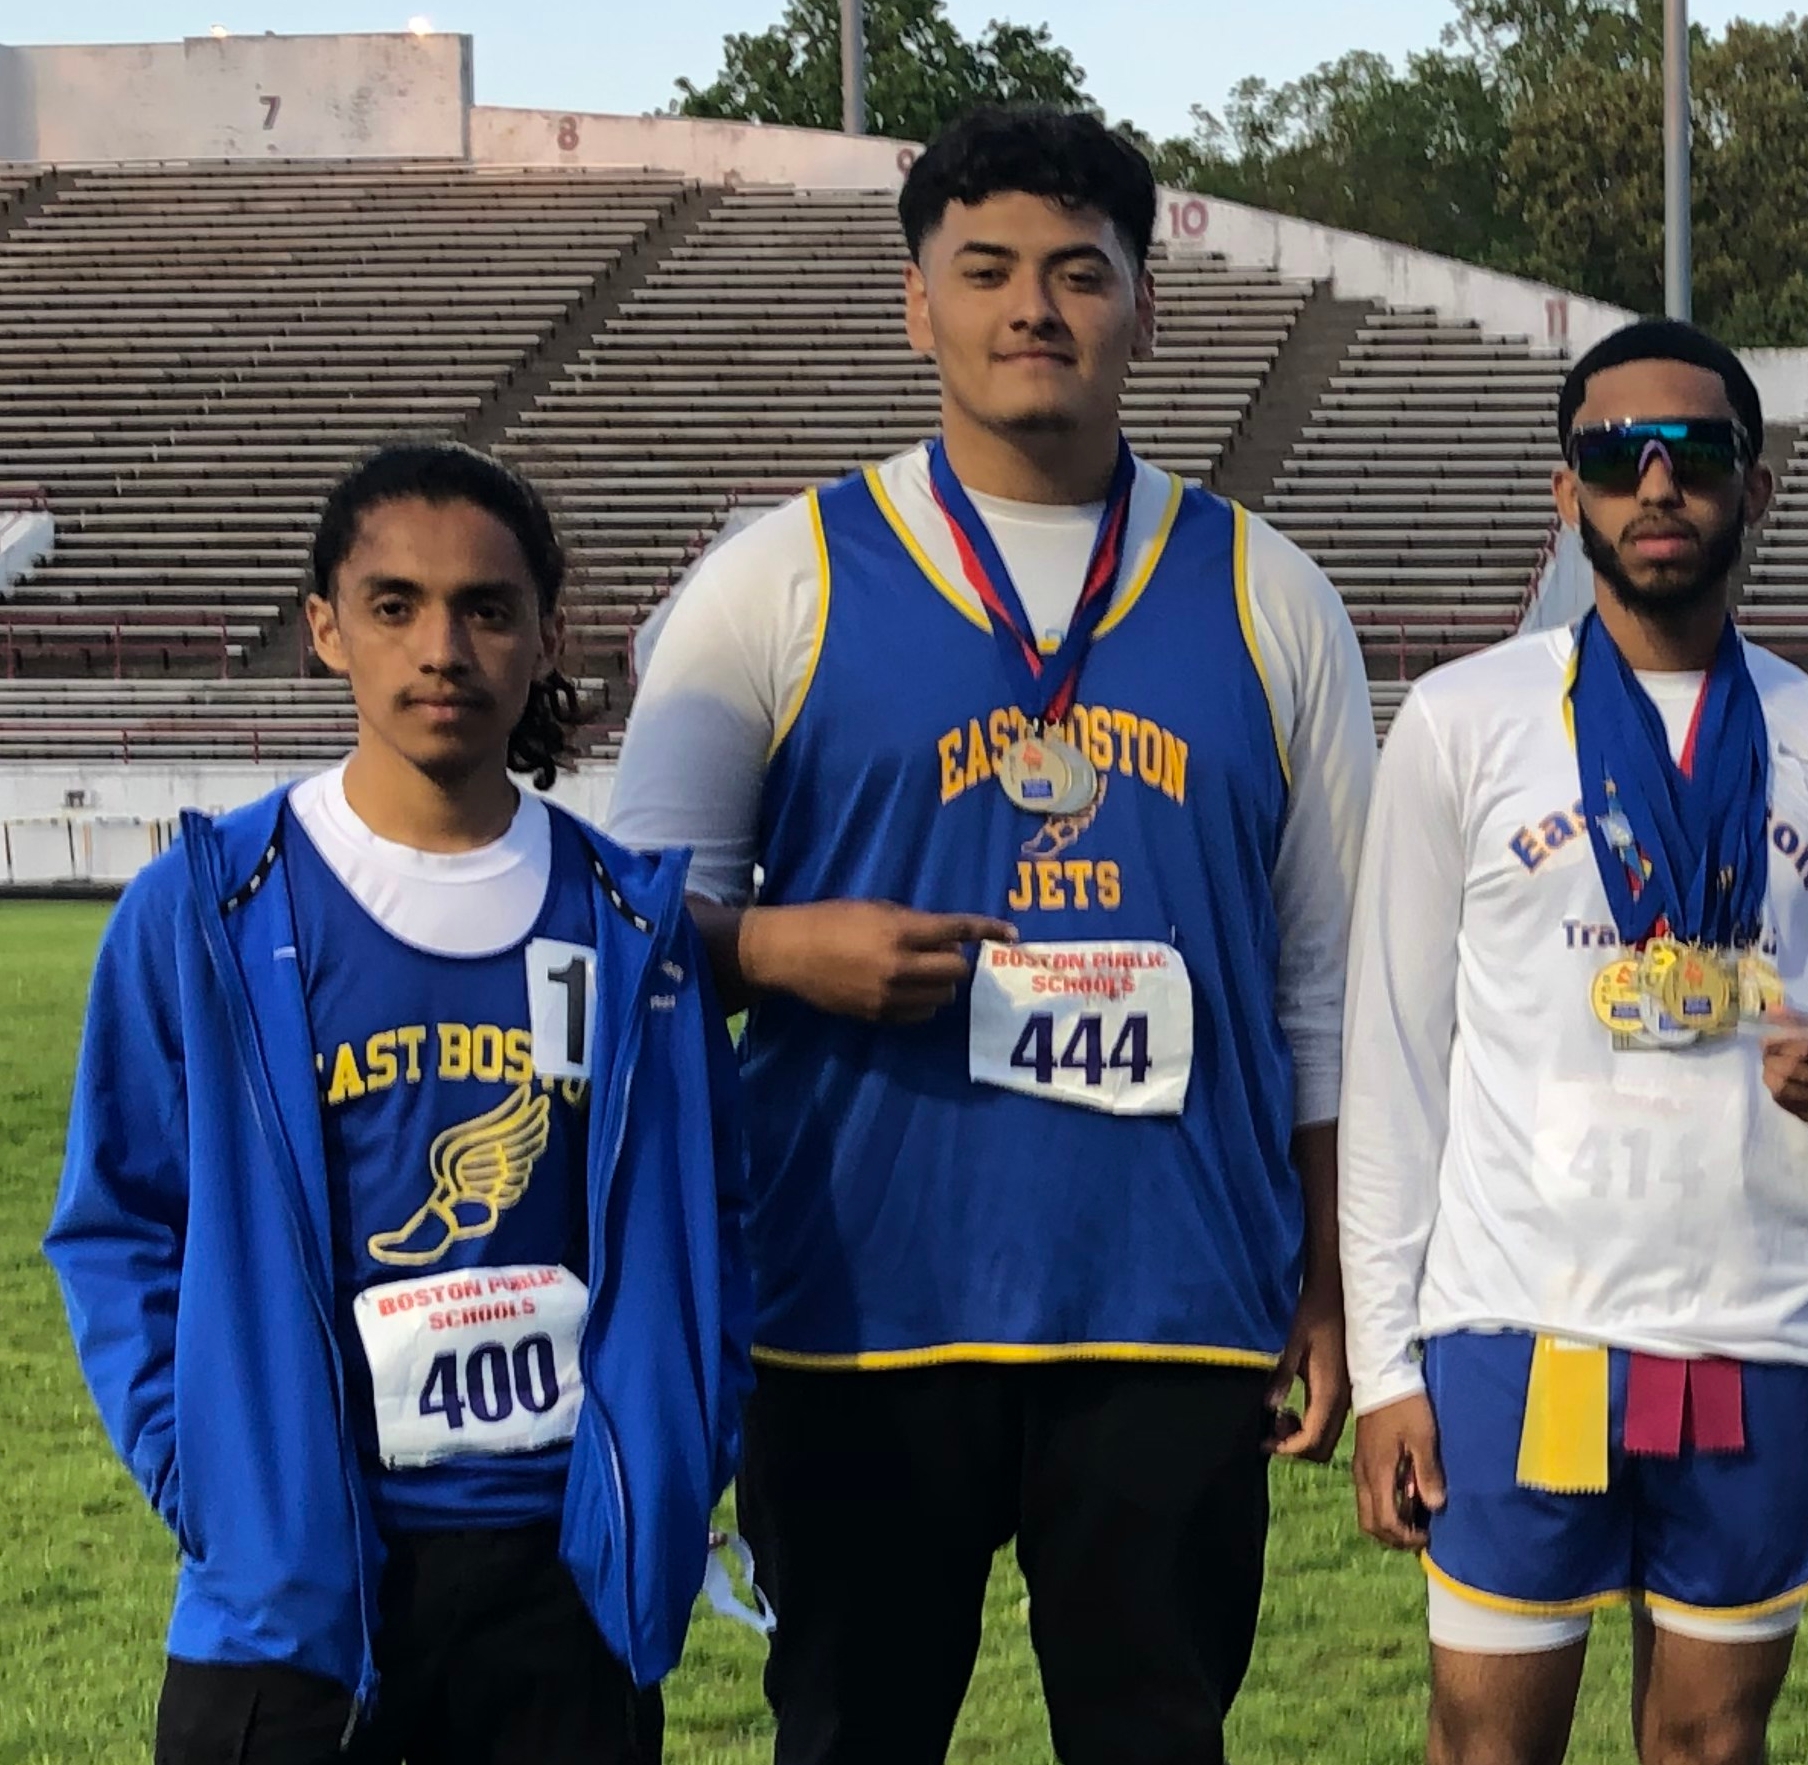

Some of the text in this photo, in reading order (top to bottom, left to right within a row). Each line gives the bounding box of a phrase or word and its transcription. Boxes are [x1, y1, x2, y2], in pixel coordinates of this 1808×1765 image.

[259, 95, 281, 130] 7
[556, 116, 579, 151] 8
[1168, 200, 1209, 238] 10
[1545, 299, 1569, 338] 11
[1062, 703, 1189, 807] OSTON
[1008, 860, 1122, 911] JETS
[991, 949, 1168, 971] BOSTON PUBLIC
[548, 954, 587, 1066] 1
[1031, 975, 1136, 996] SCHOOLS
[316, 1023, 426, 1106] AST
[1010, 1010, 1153, 1086] 444
[1568, 1125, 1707, 1199] 414
[378, 1268, 564, 1318] BOSTON PUBLIC
[428, 1297, 537, 1331] SCHOOLS
[419, 1331, 560, 1429] 400
